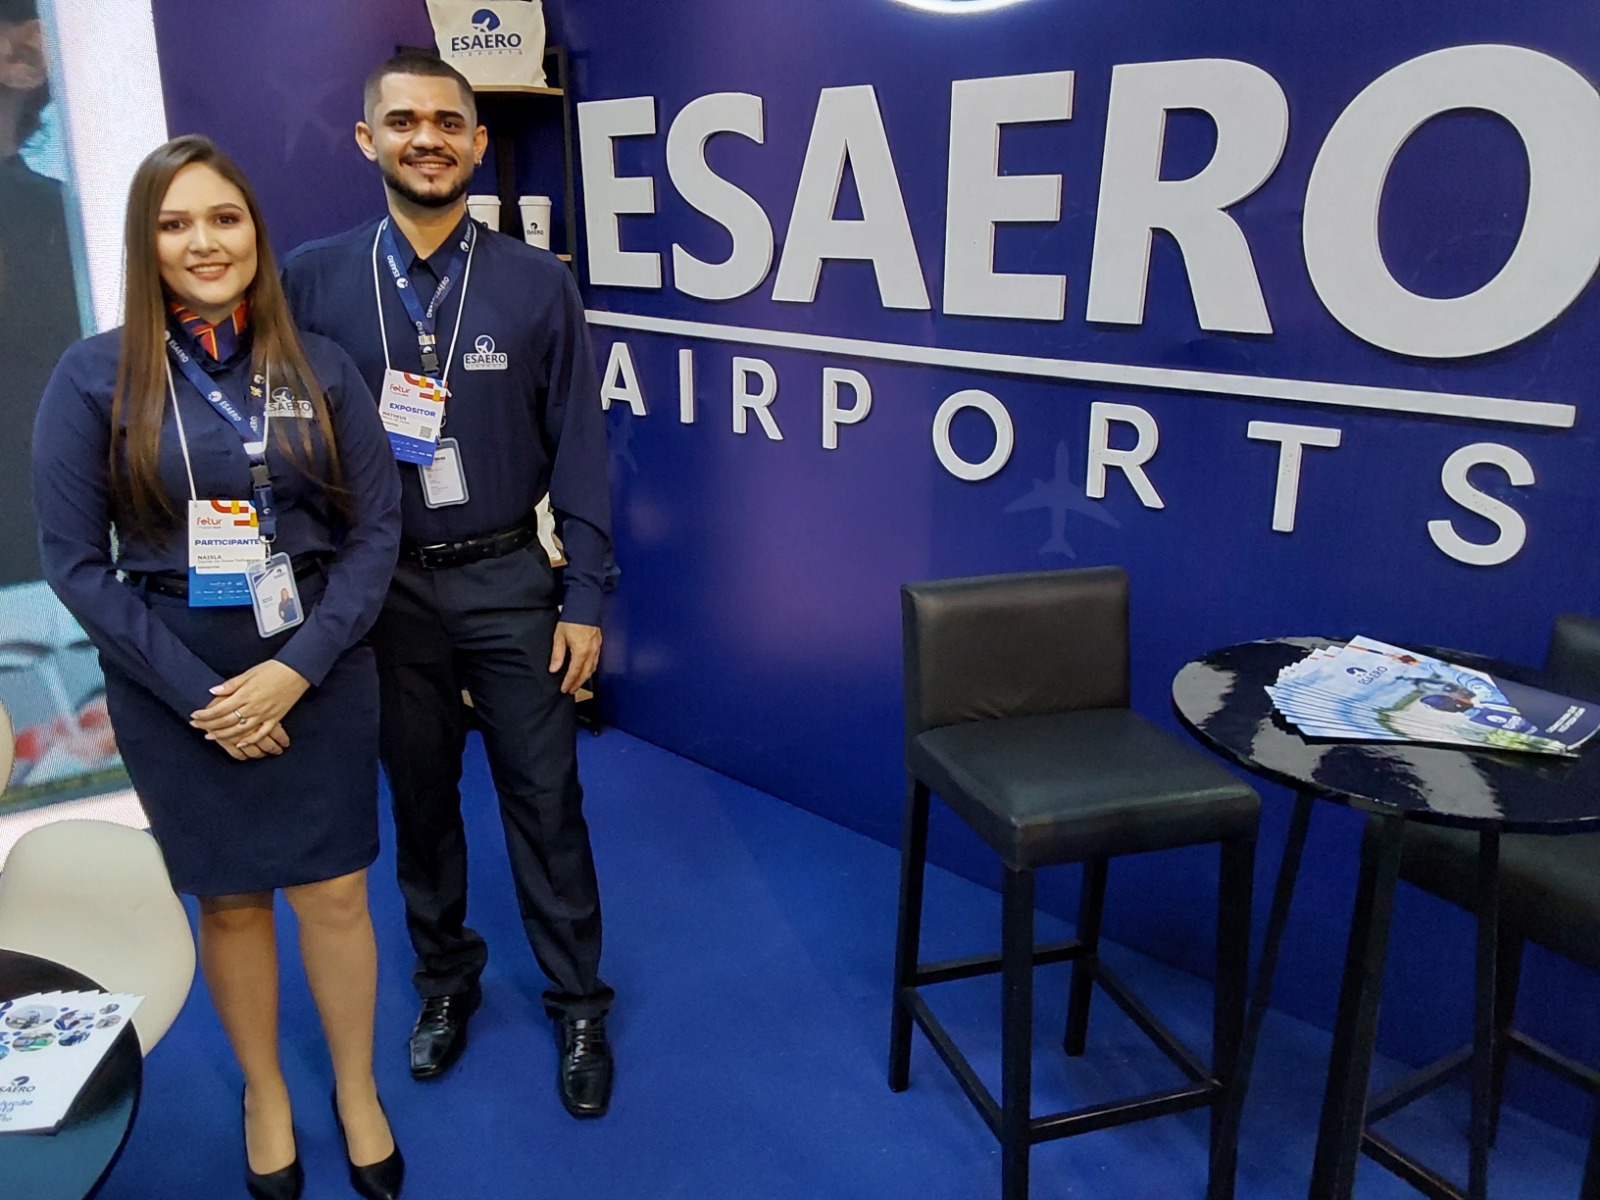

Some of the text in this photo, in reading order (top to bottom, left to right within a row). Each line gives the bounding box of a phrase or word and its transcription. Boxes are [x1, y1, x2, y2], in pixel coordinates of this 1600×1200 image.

[451, 33, 522, 52] ESAERO
[577, 43, 1600, 358] ESAERO
[387, 254, 401, 278] ESAERO
[168, 339, 190, 363] ESAERO
[465, 354, 507, 364] ESAERO
[219, 400, 242, 422] ESAERO
[389, 402, 436, 417] EXPOSITOR
[599, 341, 1536, 566] AIRPORTS
[196, 517, 222, 526] fetur
[0, 1085, 36, 1093] SAERO
